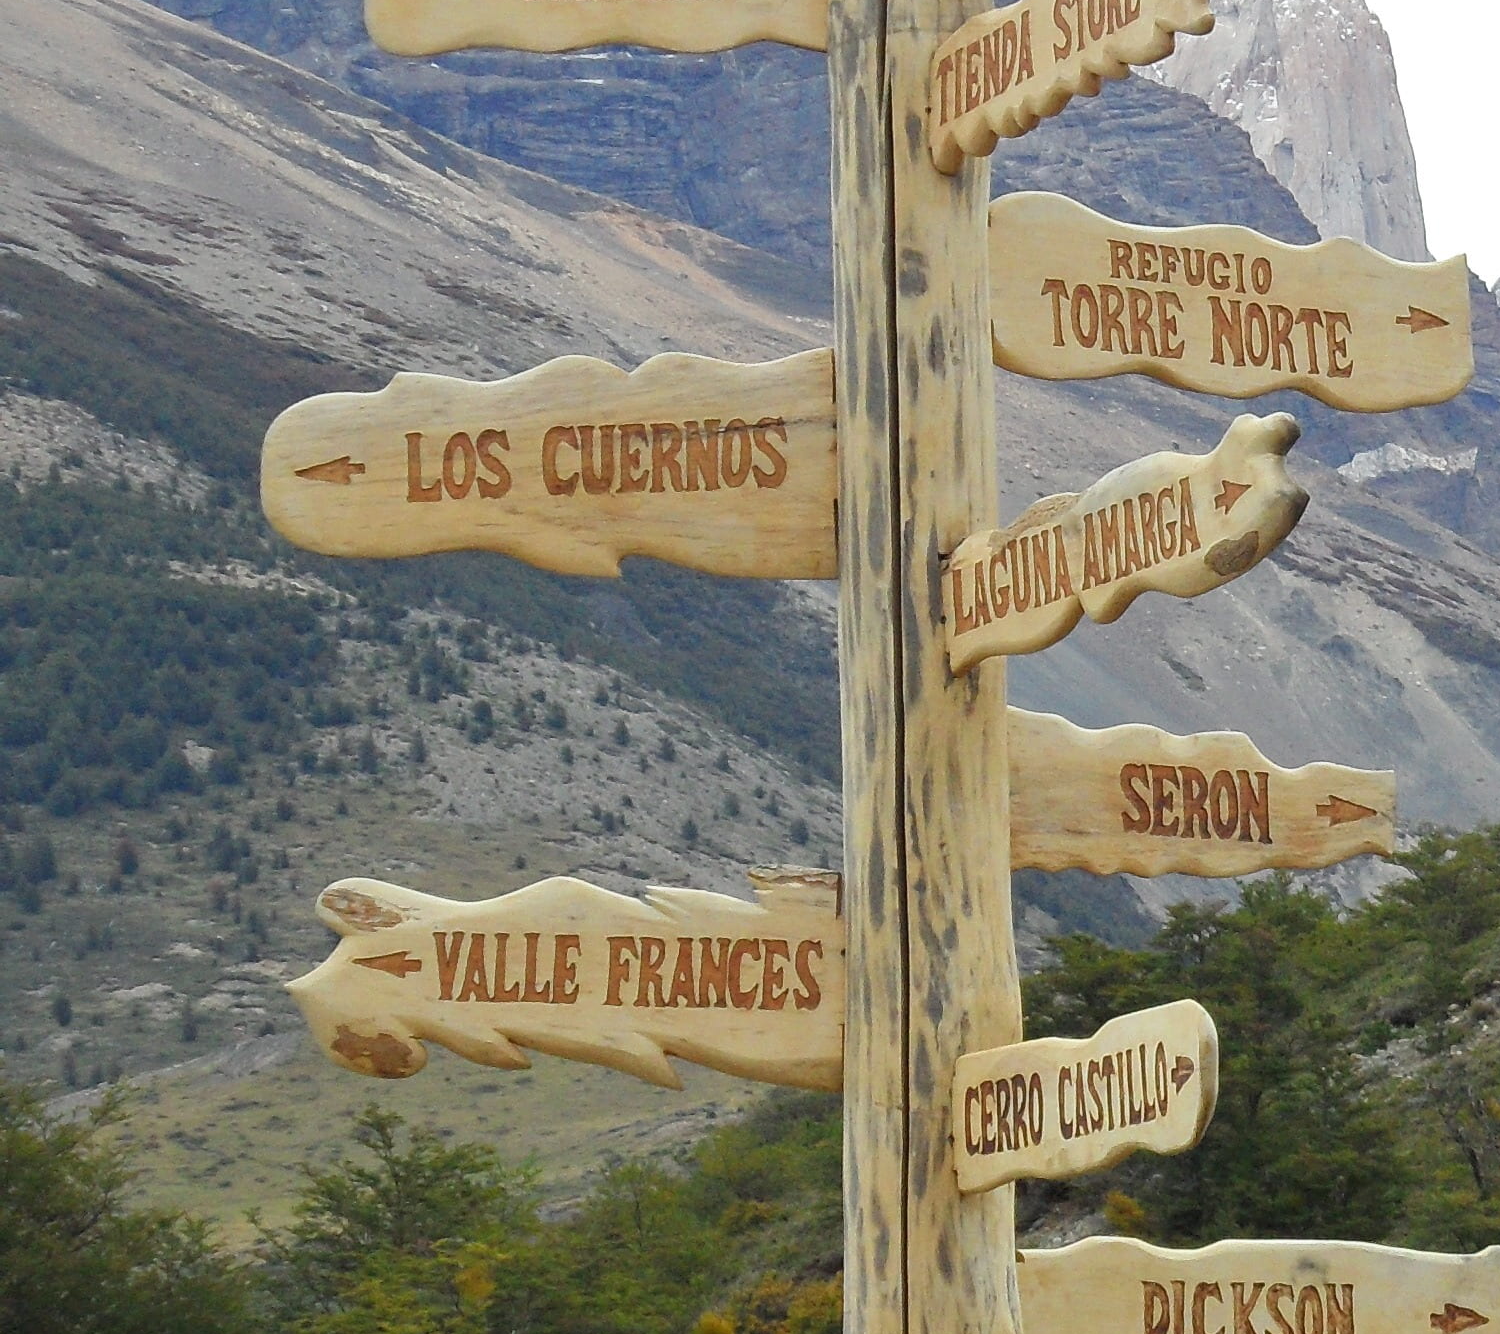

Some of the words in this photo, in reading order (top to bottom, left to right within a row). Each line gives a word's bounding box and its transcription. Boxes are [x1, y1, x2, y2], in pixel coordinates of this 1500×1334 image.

[936, 9, 1035, 127] TIENDA
[1107, 239, 1272, 295] REFUGIO
[1041, 278, 1185, 359] TORRE
[1207, 295, 1354, 378] NORTE
[405, 428, 512, 503] LOS
[542, 416, 788, 497] CUERNOS
[952, 524, 1074, 637] LAGUNA
[1082, 475, 1202, 591] AMARGA
[1120, 763, 1273, 845] SERON
[432, 931, 581, 1005] VALLE
[602, 935, 824, 1011] FRANCES
[964, 1072, 1044, 1156] CERRO
[1058, 1041, 1168, 1140] CASTILLO
